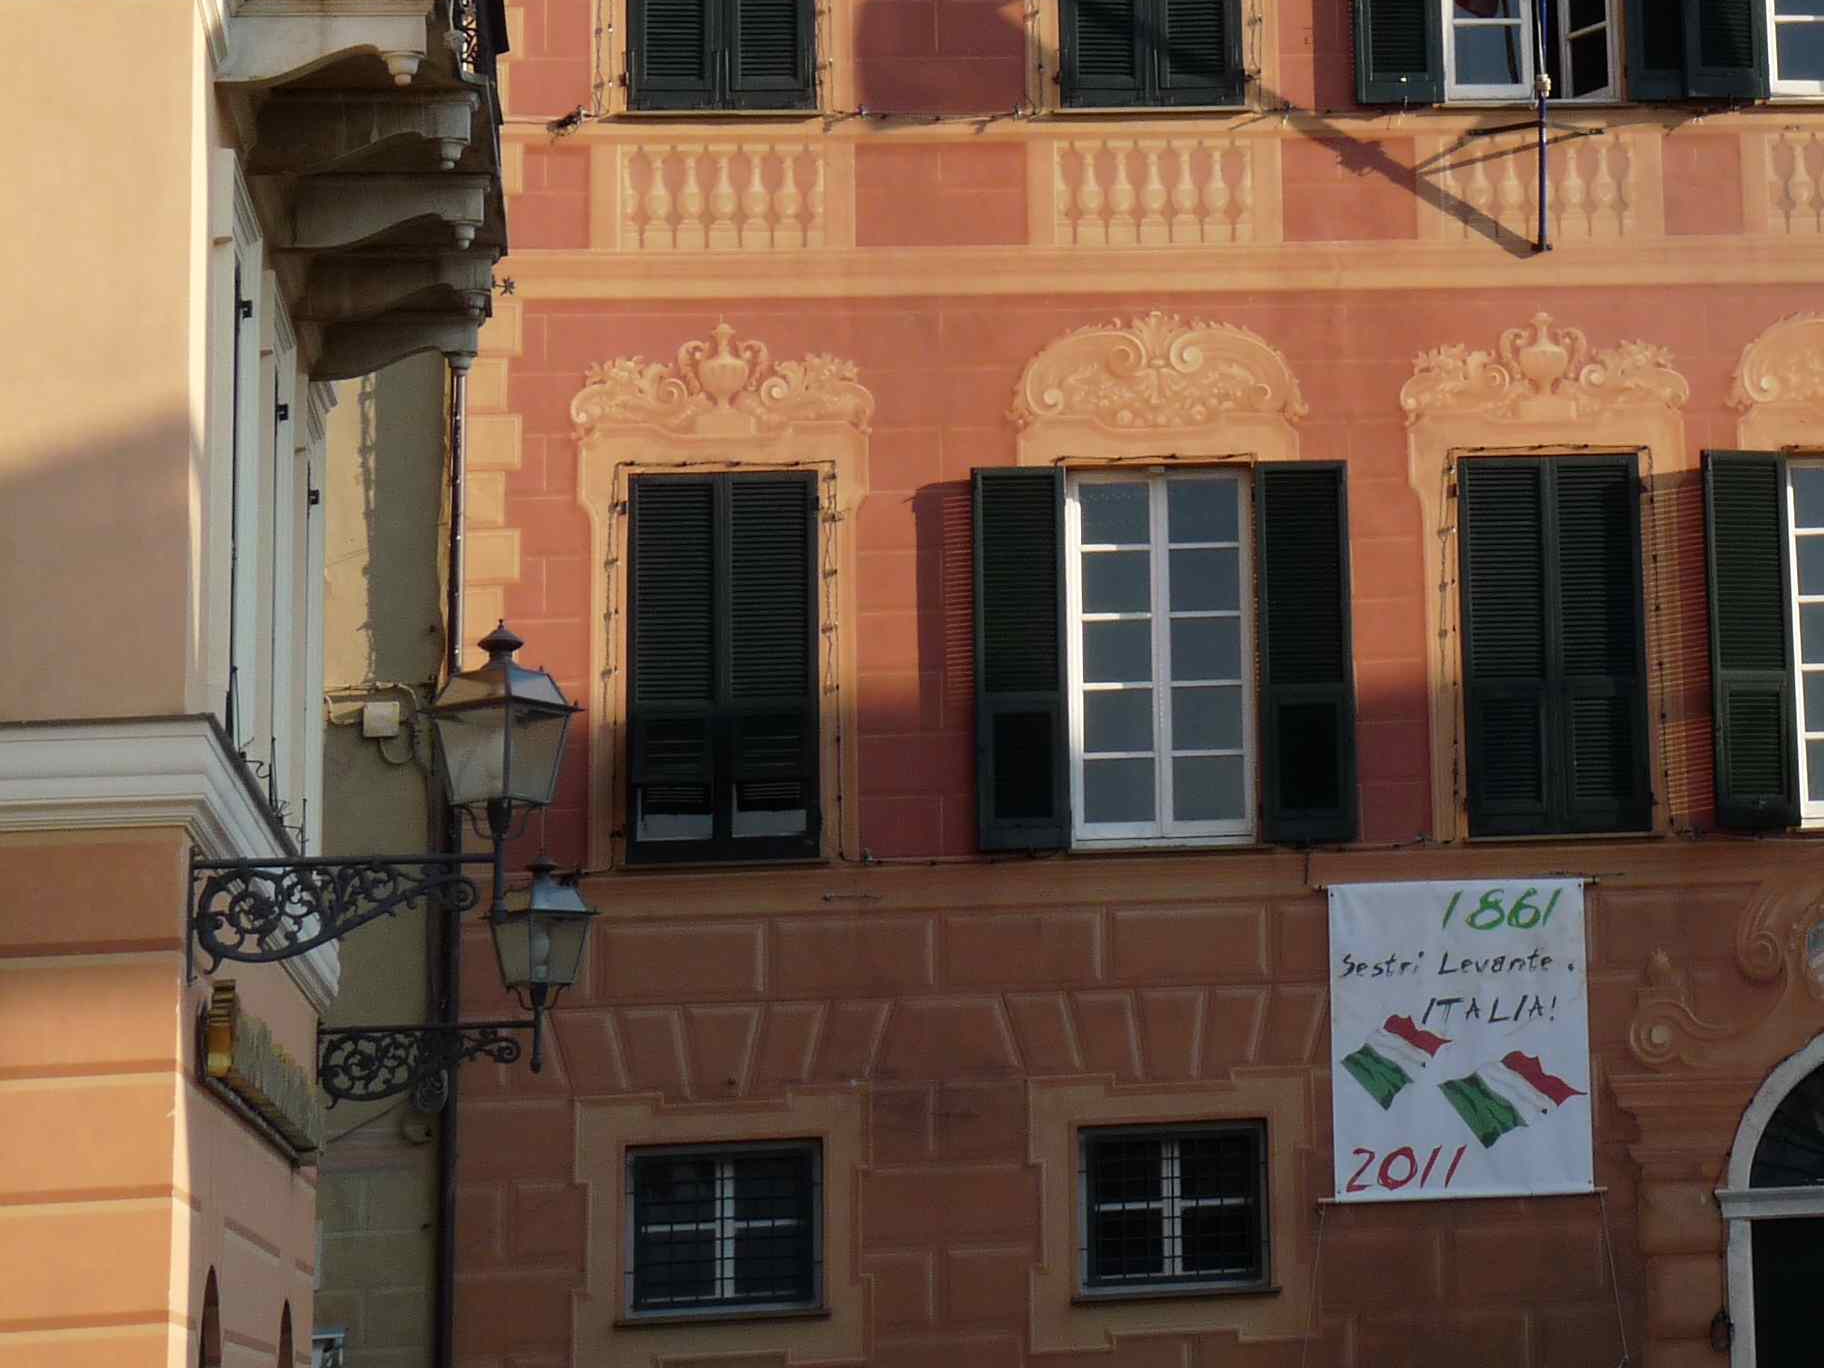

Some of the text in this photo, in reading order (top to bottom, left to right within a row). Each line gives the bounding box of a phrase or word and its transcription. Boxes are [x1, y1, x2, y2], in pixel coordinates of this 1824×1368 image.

[1442, 887, 1563, 931] 1861
[1342, 947, 1553, 978] Sestri Levante
[1422, 993, 1557, 1024] ITALIA!
[1346, 1143, 1467, 1192] 2011
